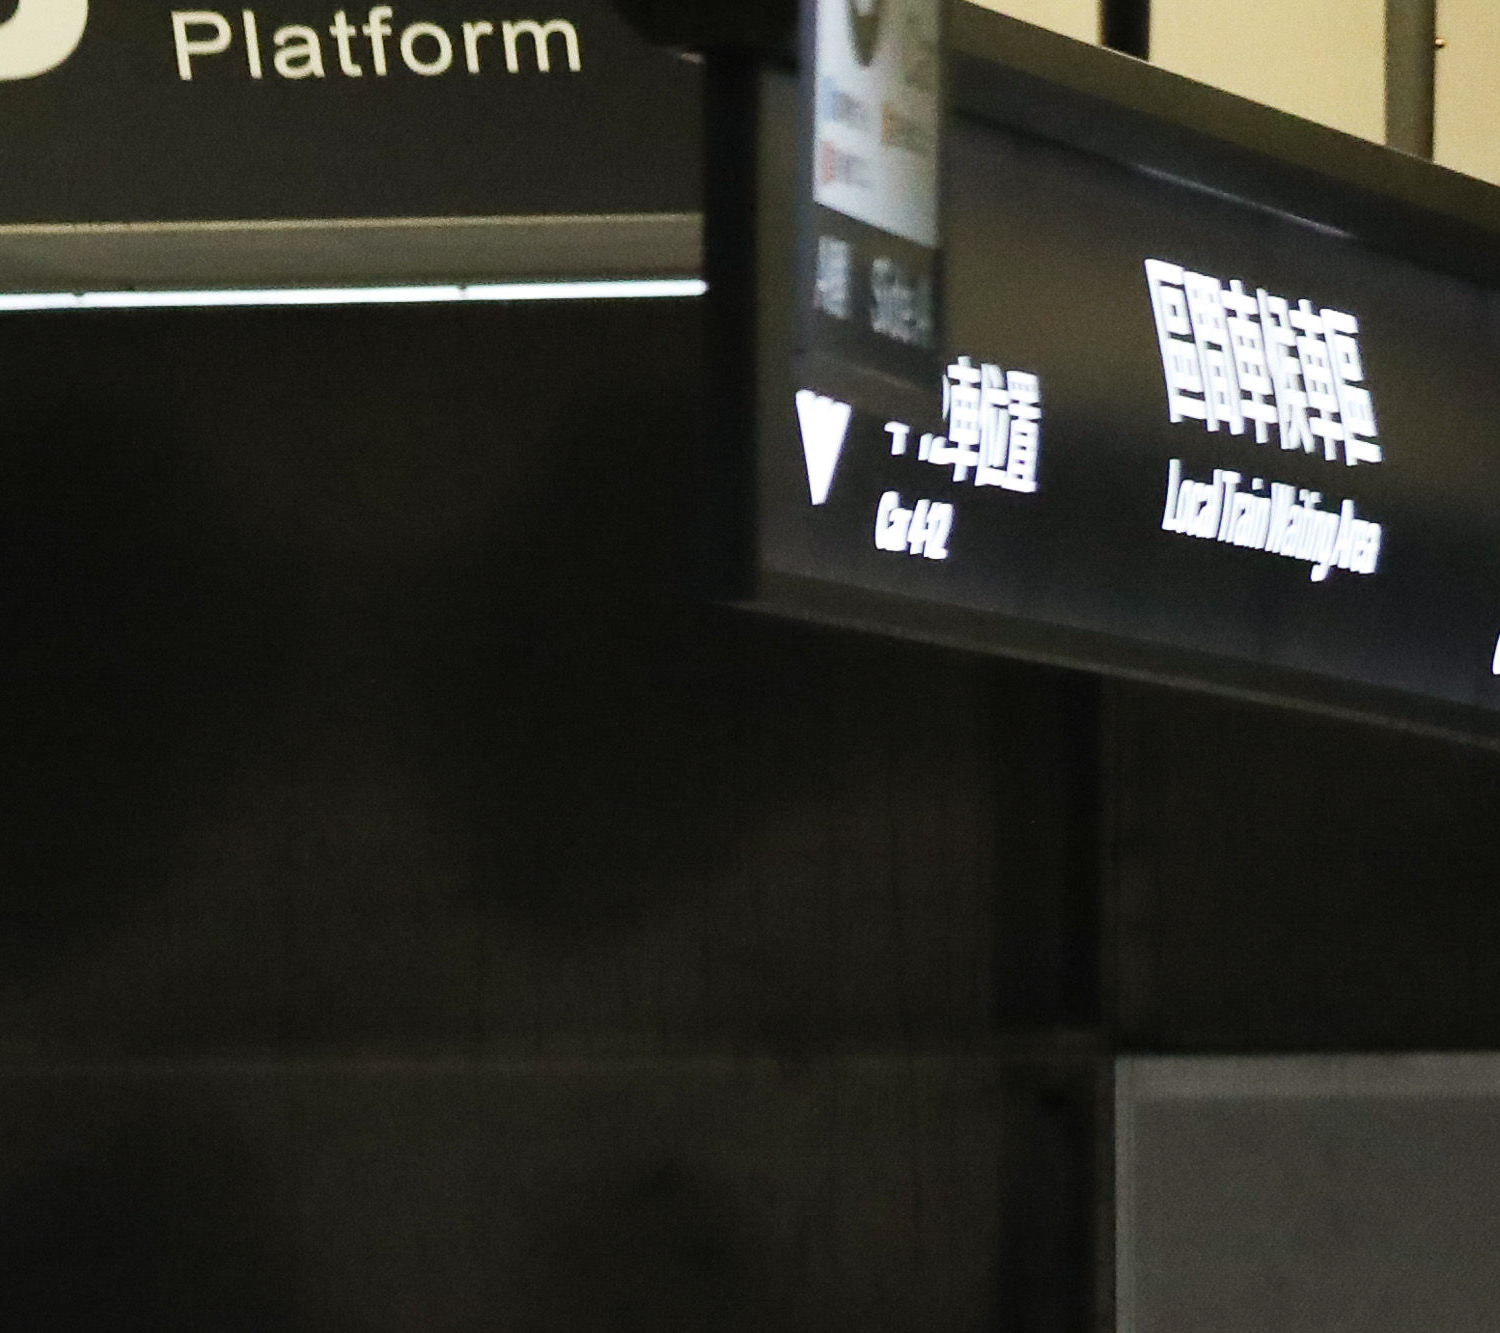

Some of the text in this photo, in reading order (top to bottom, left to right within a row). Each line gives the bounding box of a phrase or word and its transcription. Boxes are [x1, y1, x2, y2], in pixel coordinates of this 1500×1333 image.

[172, 7, 584, 81] Platform
[1143, 257, 1384, 467] 區間車候車區
[1161, 457, 1384, 583] Local Train Waiting Area
